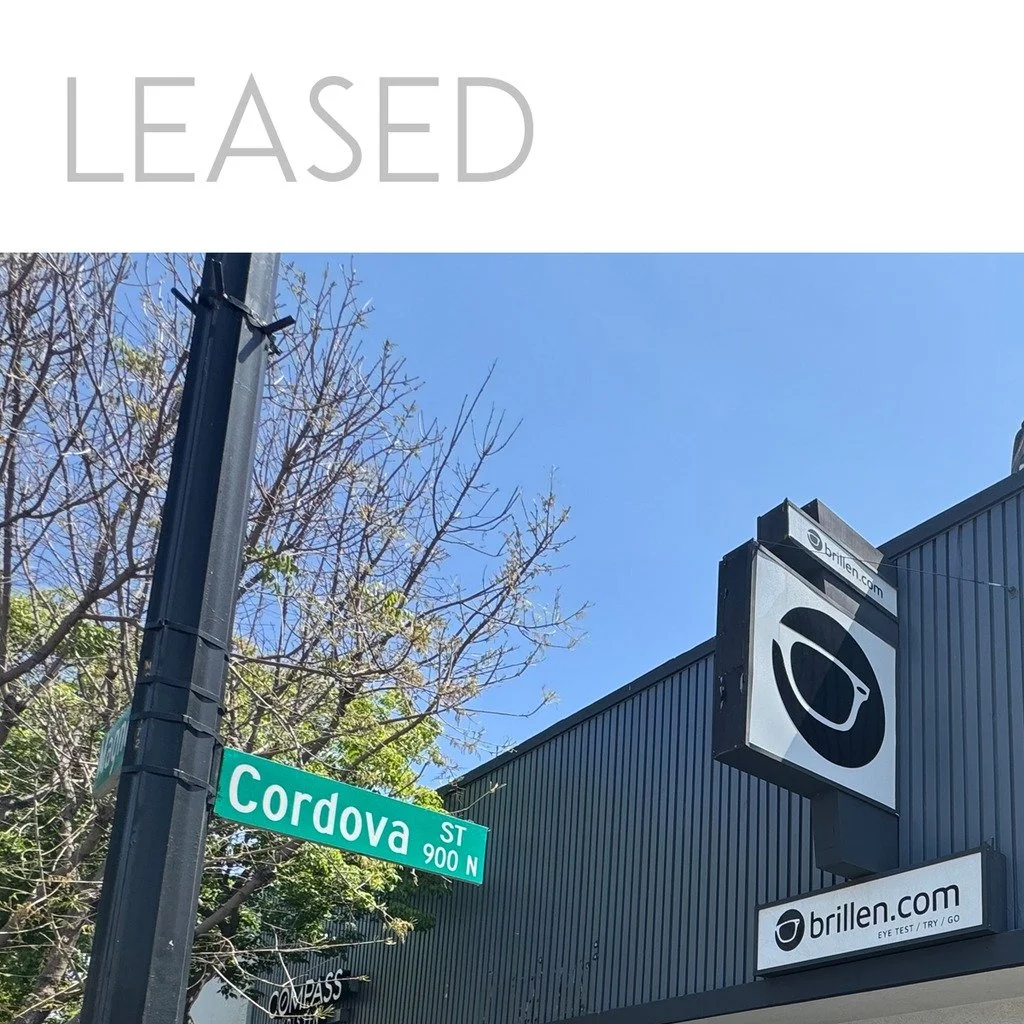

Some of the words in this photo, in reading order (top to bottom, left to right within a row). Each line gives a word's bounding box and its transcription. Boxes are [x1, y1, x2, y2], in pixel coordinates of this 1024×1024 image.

[824, 542, 884, 599] brillen.com
[228, 763, 410, 855] Cordova
[440, 822, 467, 847] ST
[423, 844, 459, 873] 900
[465, 855, 479, 878] N
[810, 884, 960, 939] brillen.com
[878, 928, 892, 939] EYE
[895, 924, 914, 936] TEST
[923, 919, 939, 930] TRY
[947, 914, 960, 924] GO
[268, 968, 343, 1016] COMPASS
